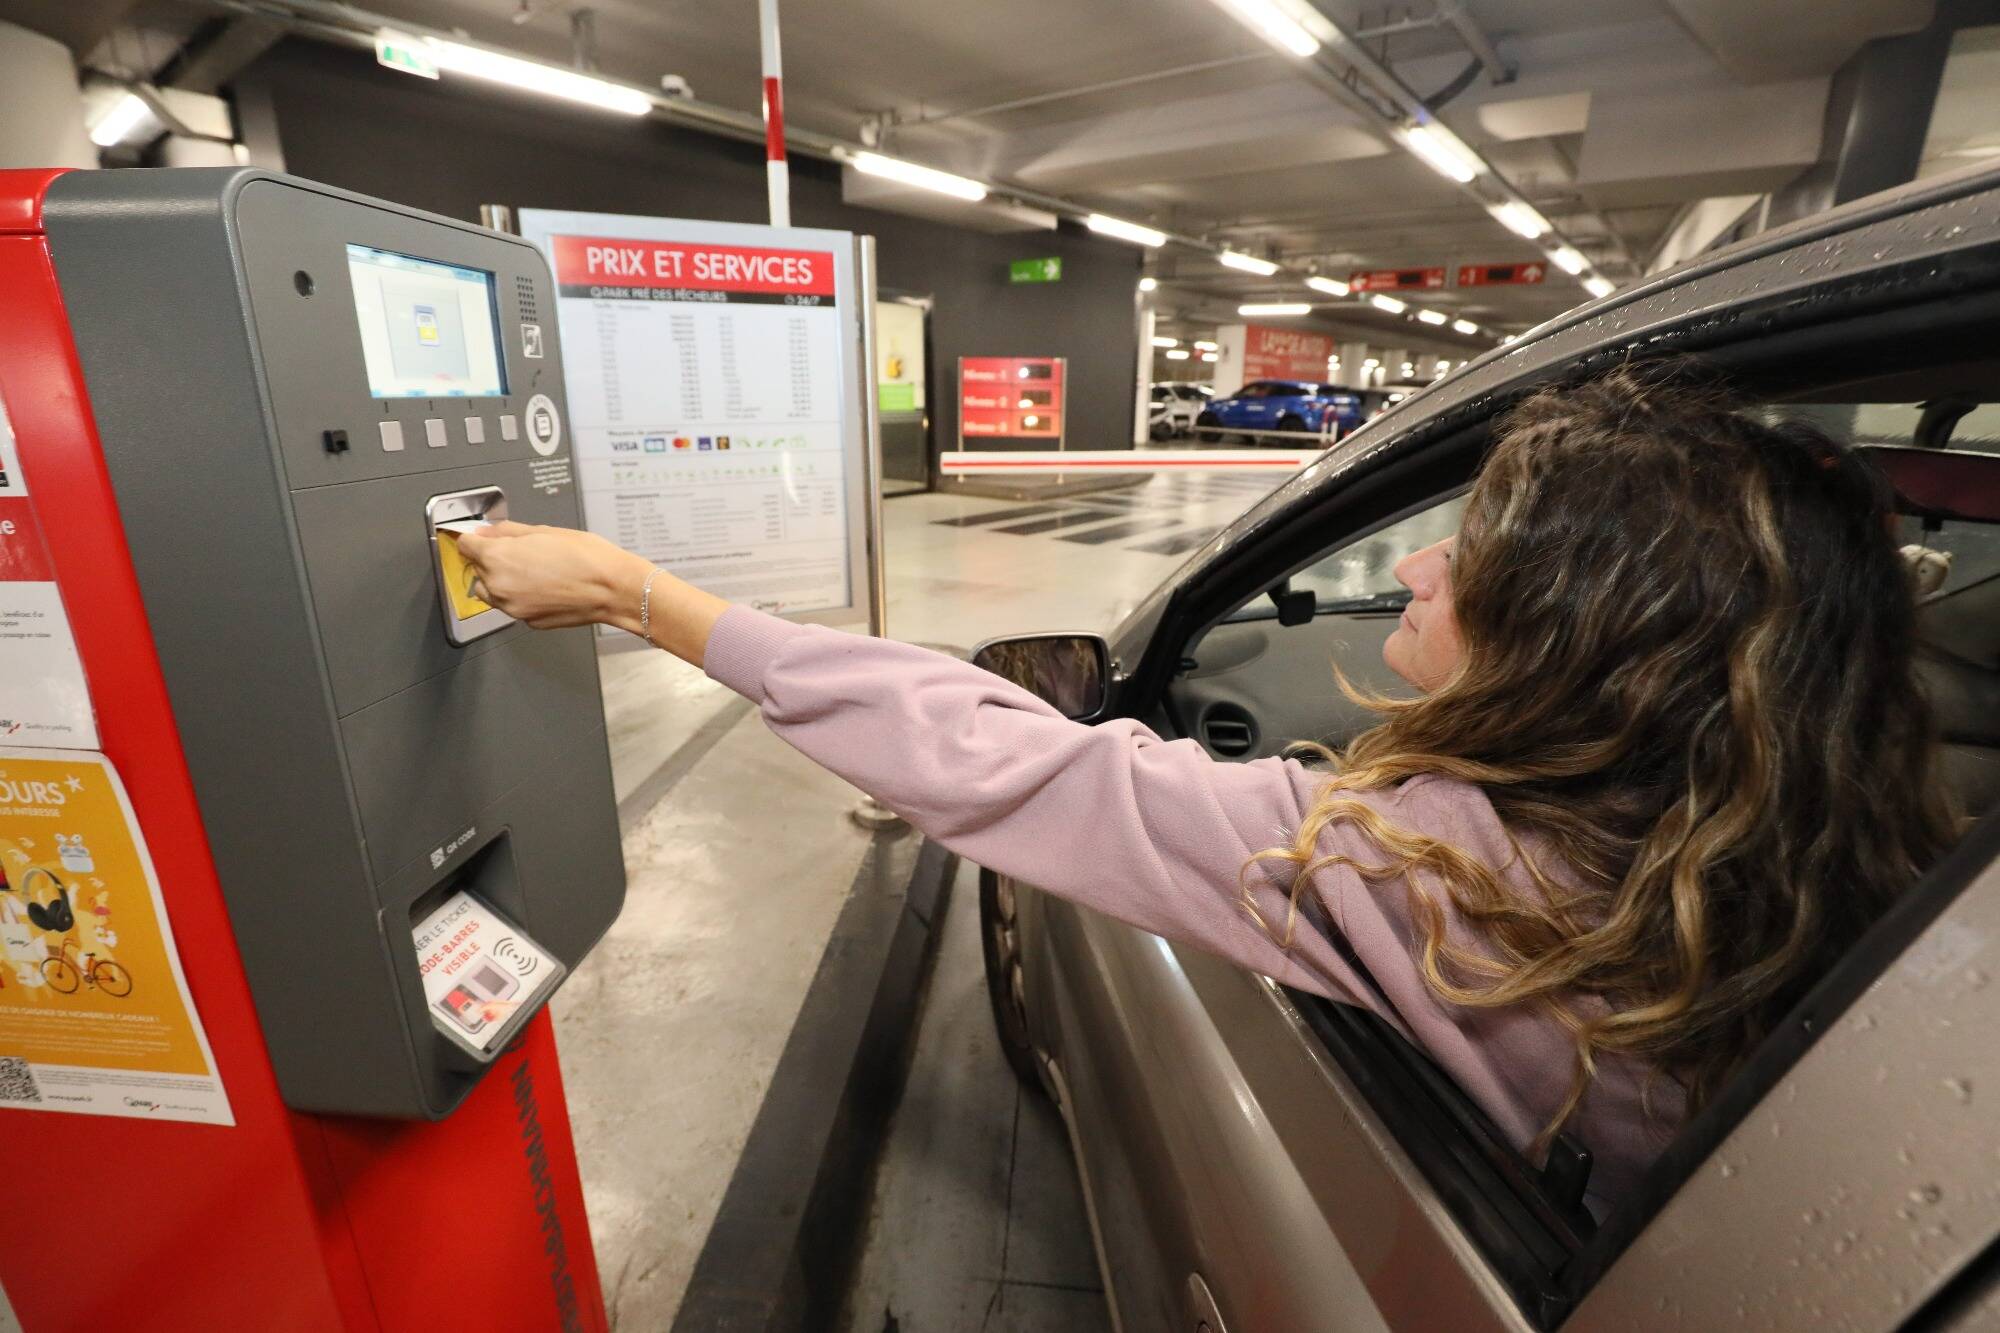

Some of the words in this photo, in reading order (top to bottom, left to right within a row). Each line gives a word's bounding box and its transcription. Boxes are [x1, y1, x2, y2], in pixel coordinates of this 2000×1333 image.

[586, 247, 646, 276] PRIX
[654, 250, 685, 278] ET
[692, 252, 813, 284] SERVICES
[652, 289, 673, 301] DES
[611, 441, 638, 451] VISA
[0, 780, 65, 805] OURS
[446, 841, 458, 854] QR
[458, 827, 476, 845] CODE
[430, 924, 445, 938] LE
[441, 901, 473, 927] TICKET
[420, 920, 480, 977] ODE-BARRES
[441, 942, 481, 976] VISIBLE
